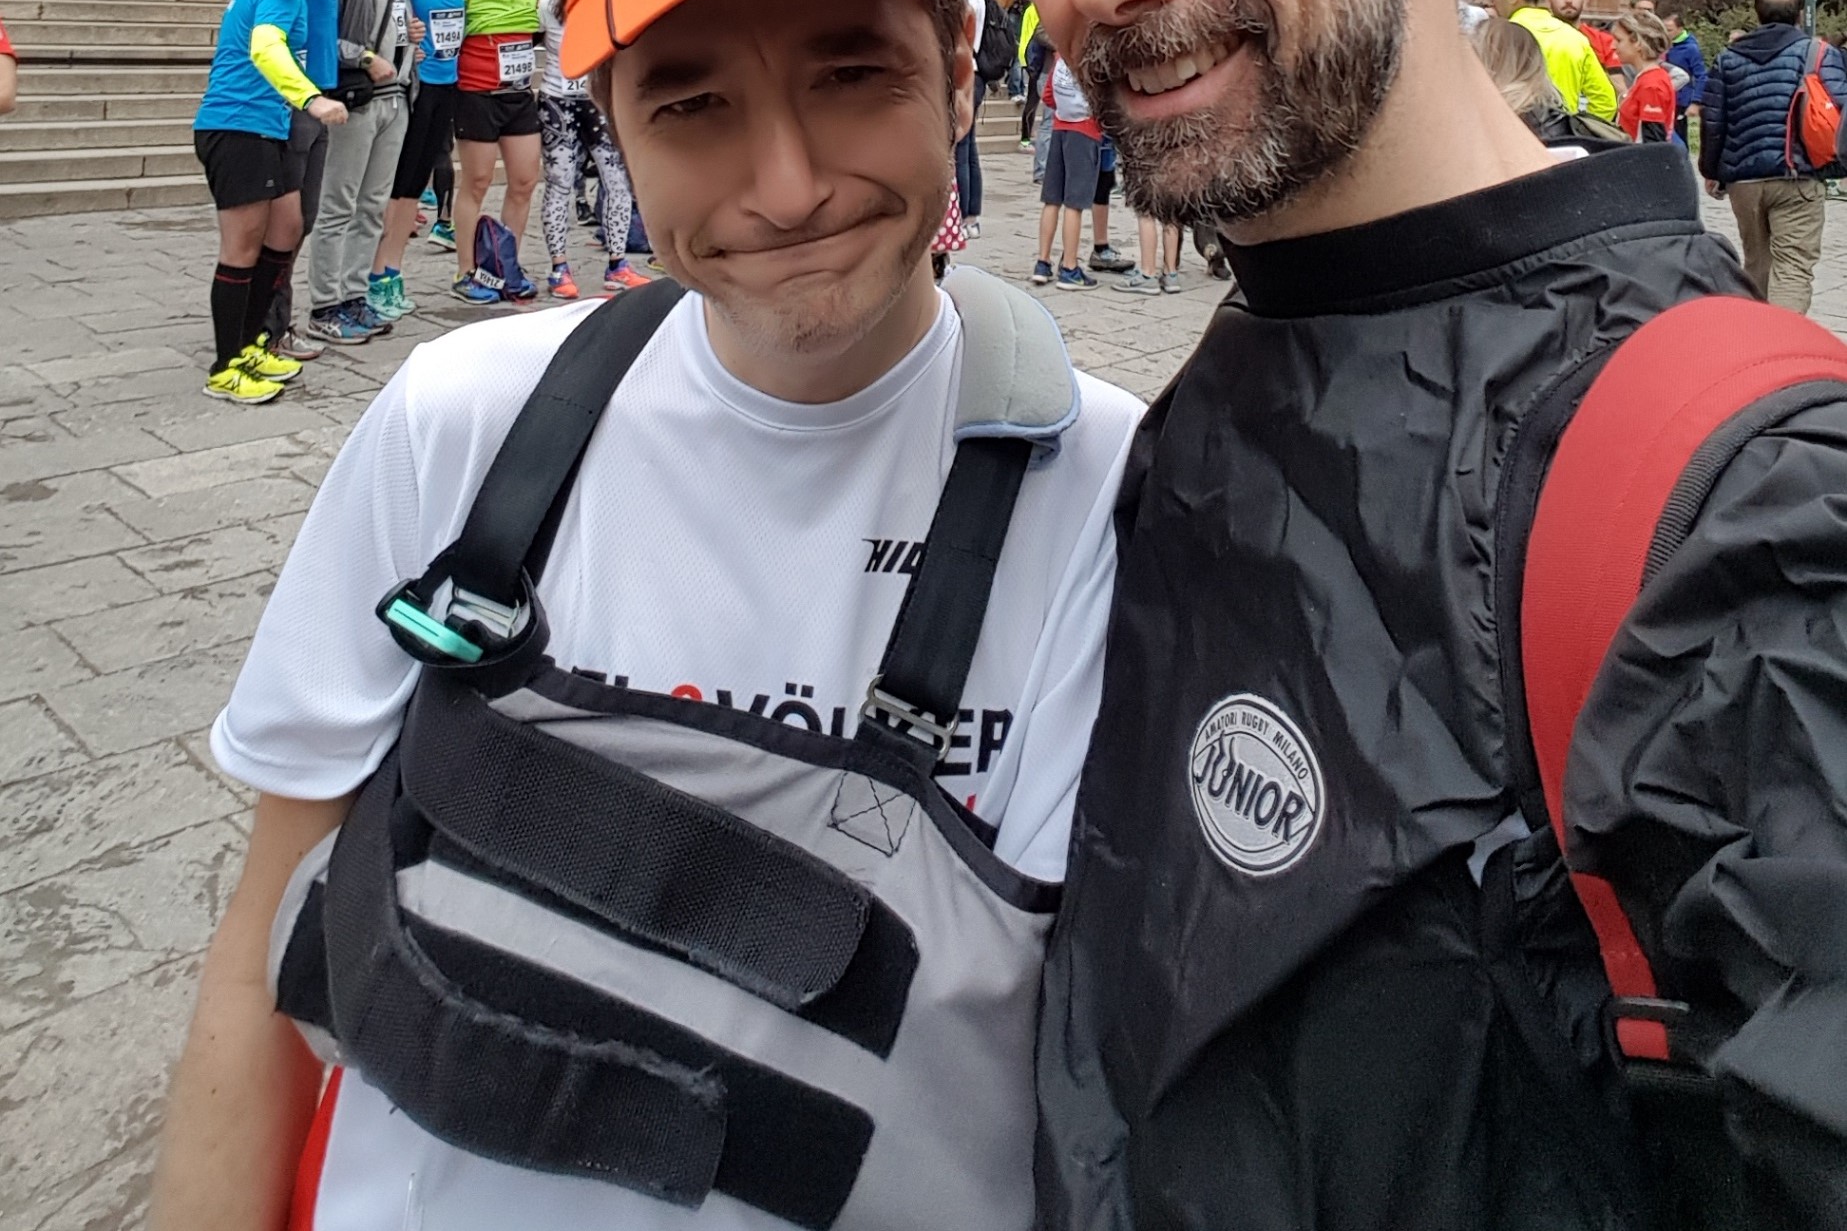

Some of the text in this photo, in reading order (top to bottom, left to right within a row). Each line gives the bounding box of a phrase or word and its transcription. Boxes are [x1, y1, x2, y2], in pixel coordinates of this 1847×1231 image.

[1194, 729, 1305, 846] JUNIOR
[1205, 711, 1309, 780] AMATORI RUGBY MILANO
